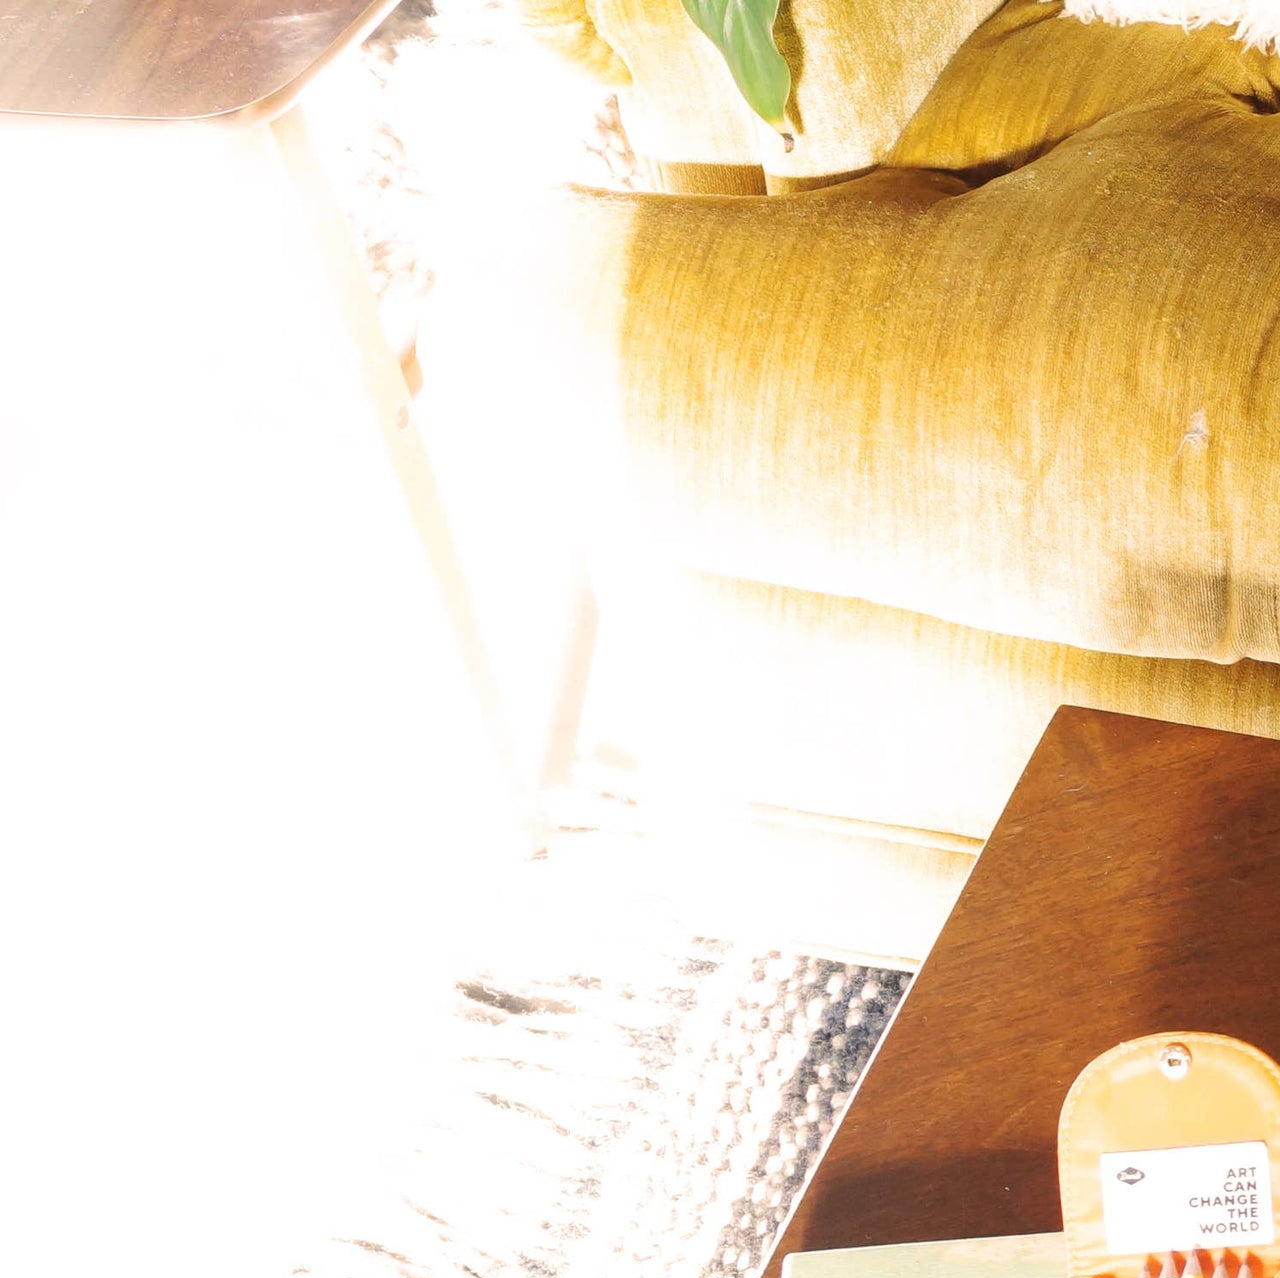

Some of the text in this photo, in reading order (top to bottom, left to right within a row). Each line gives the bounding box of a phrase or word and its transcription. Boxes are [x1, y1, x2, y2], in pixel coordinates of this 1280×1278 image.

[1226, 1166, 1257, 1179] ART
[1223, 1180, 1257, 1193] CAN
[1188, 1194, 1259, 1208] CHANGE
[1227, 1207, 1259, 1219] THE
[1199, 1221, 1260, 1234] WORLD
